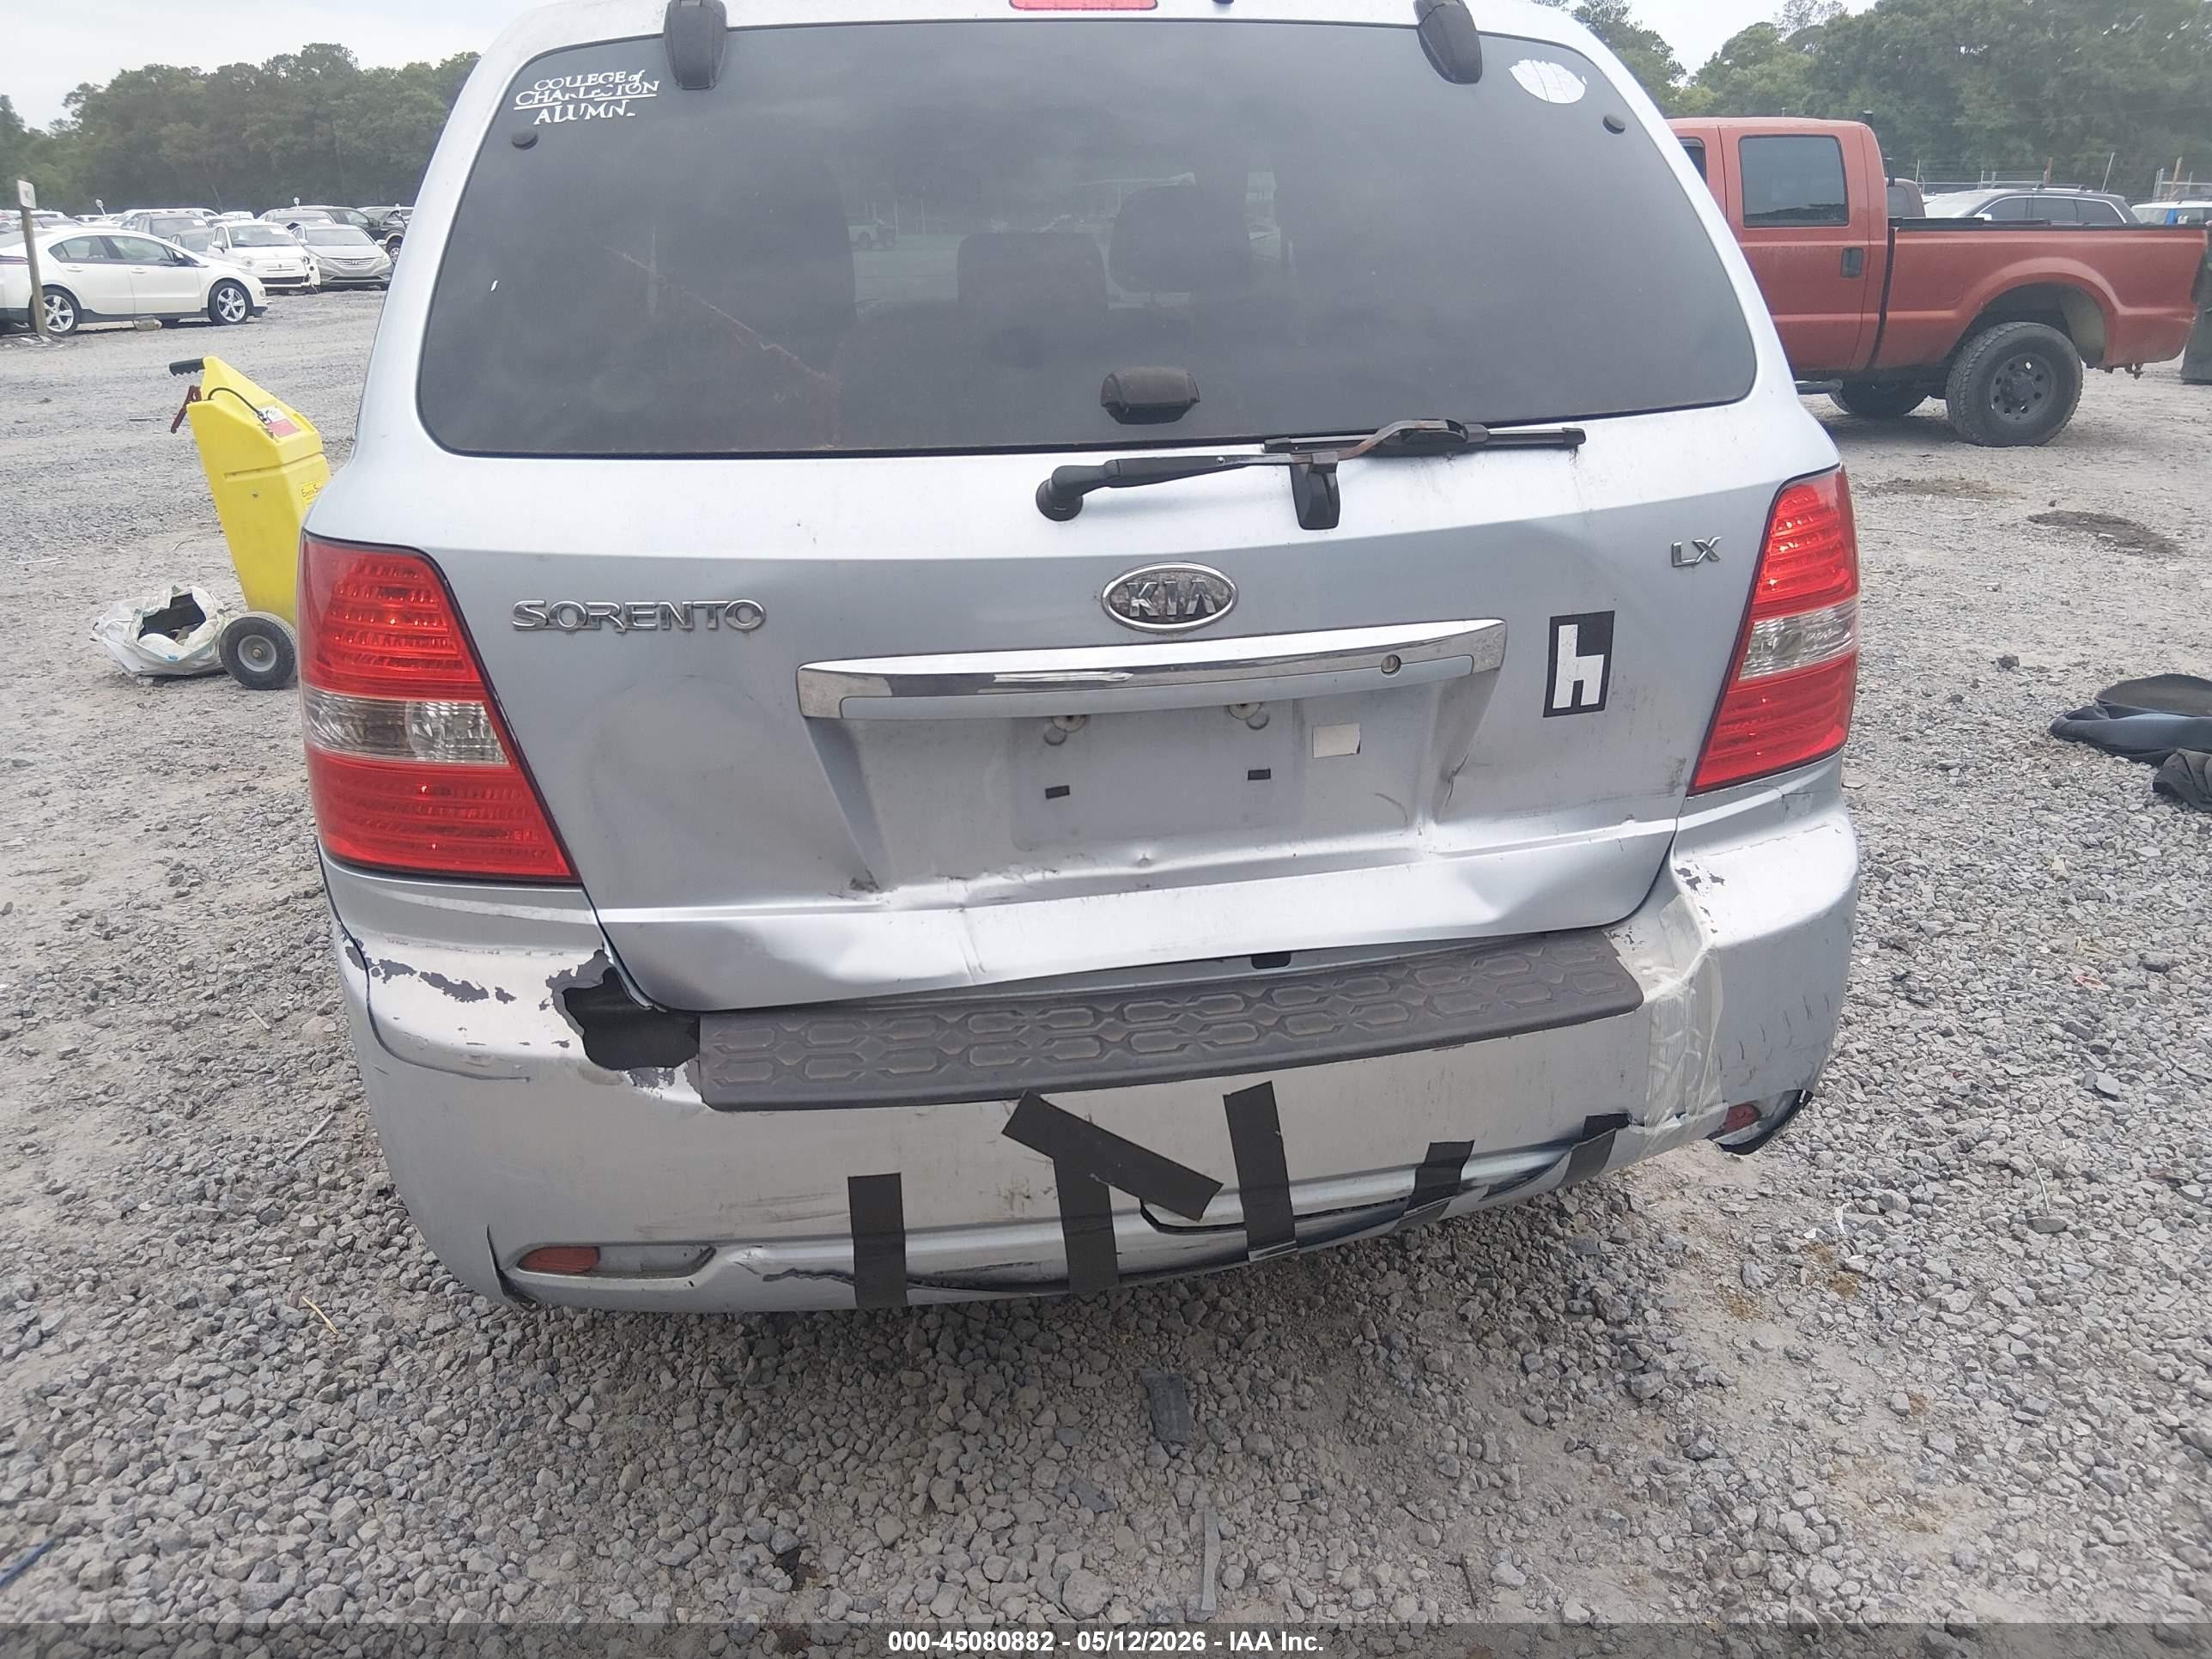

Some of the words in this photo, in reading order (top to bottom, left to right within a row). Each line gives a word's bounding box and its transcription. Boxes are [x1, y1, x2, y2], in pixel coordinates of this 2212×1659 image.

[534, 71, 627, 91] COLLEGE
[1671, 536, 1722, 568] LX
[1127, 580, 1217, 617] KIA
[512, 599, 766, 633] SORENTO
